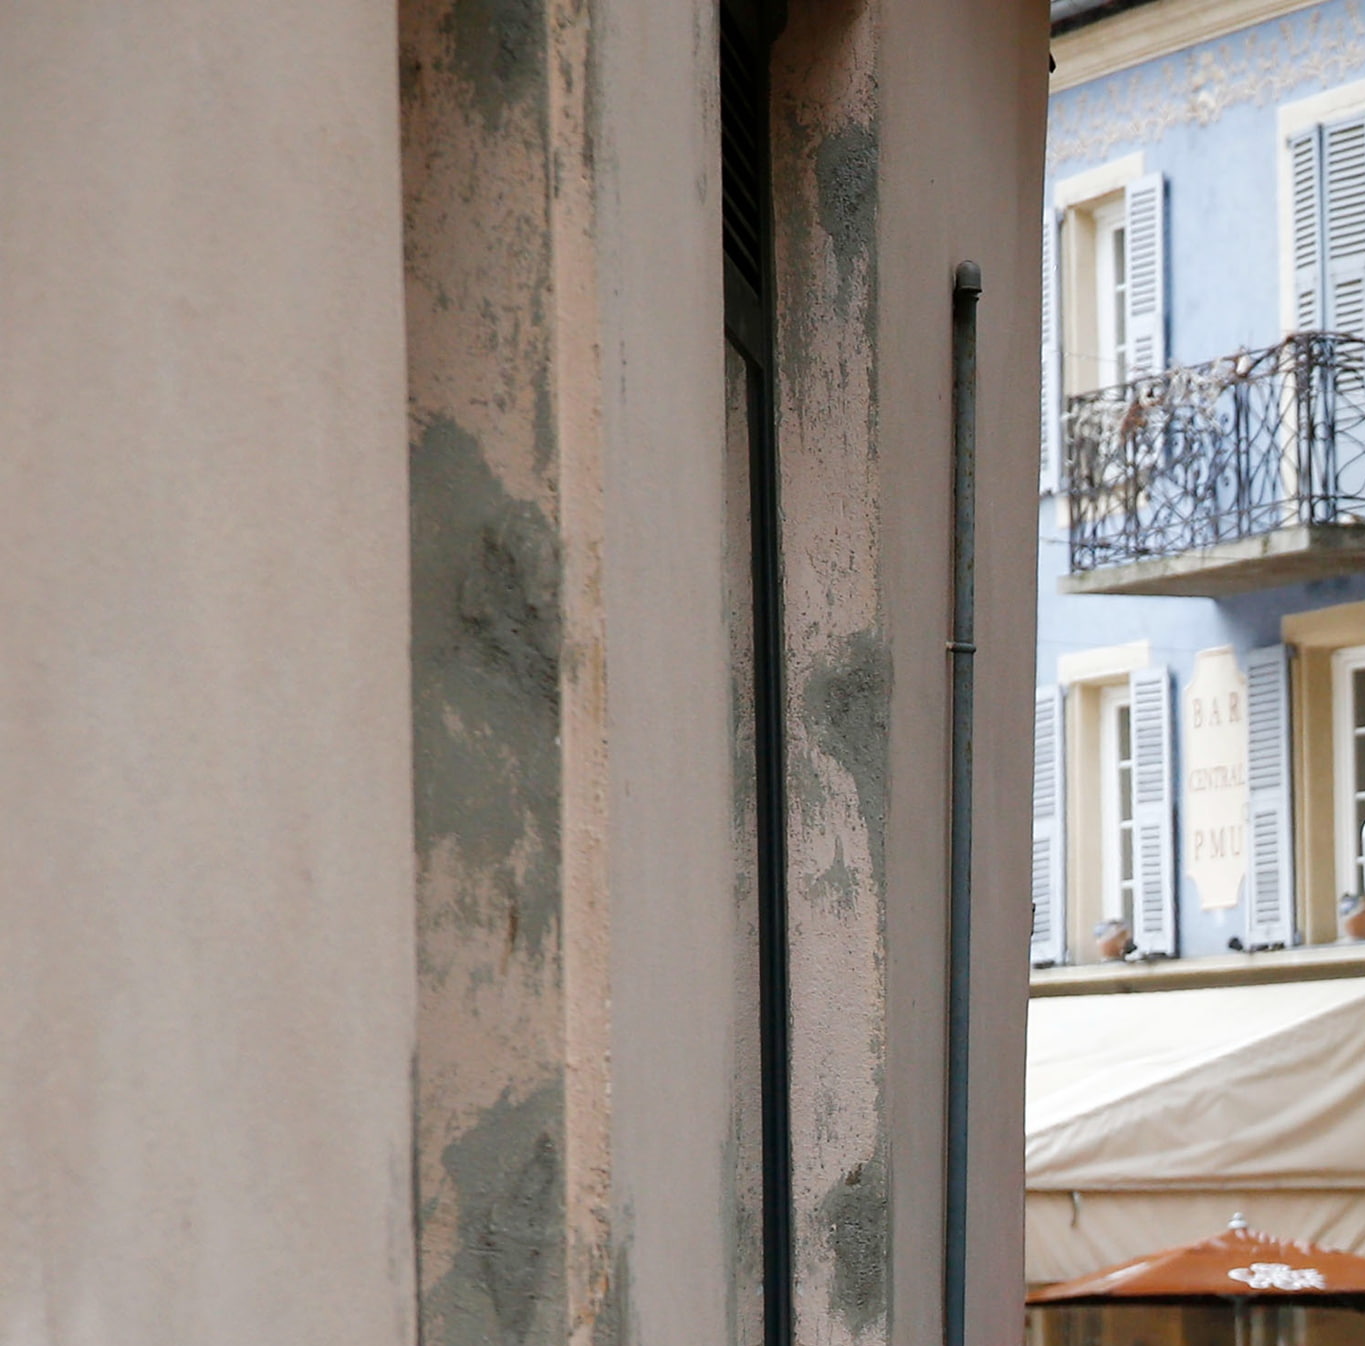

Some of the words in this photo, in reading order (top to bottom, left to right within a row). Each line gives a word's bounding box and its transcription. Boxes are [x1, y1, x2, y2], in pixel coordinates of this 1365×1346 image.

[1192, 691, 1241, 729] BAR
[1189, 762, 1246, 792] CENTRAL
[1194, 824, 1243, 862] PMU
